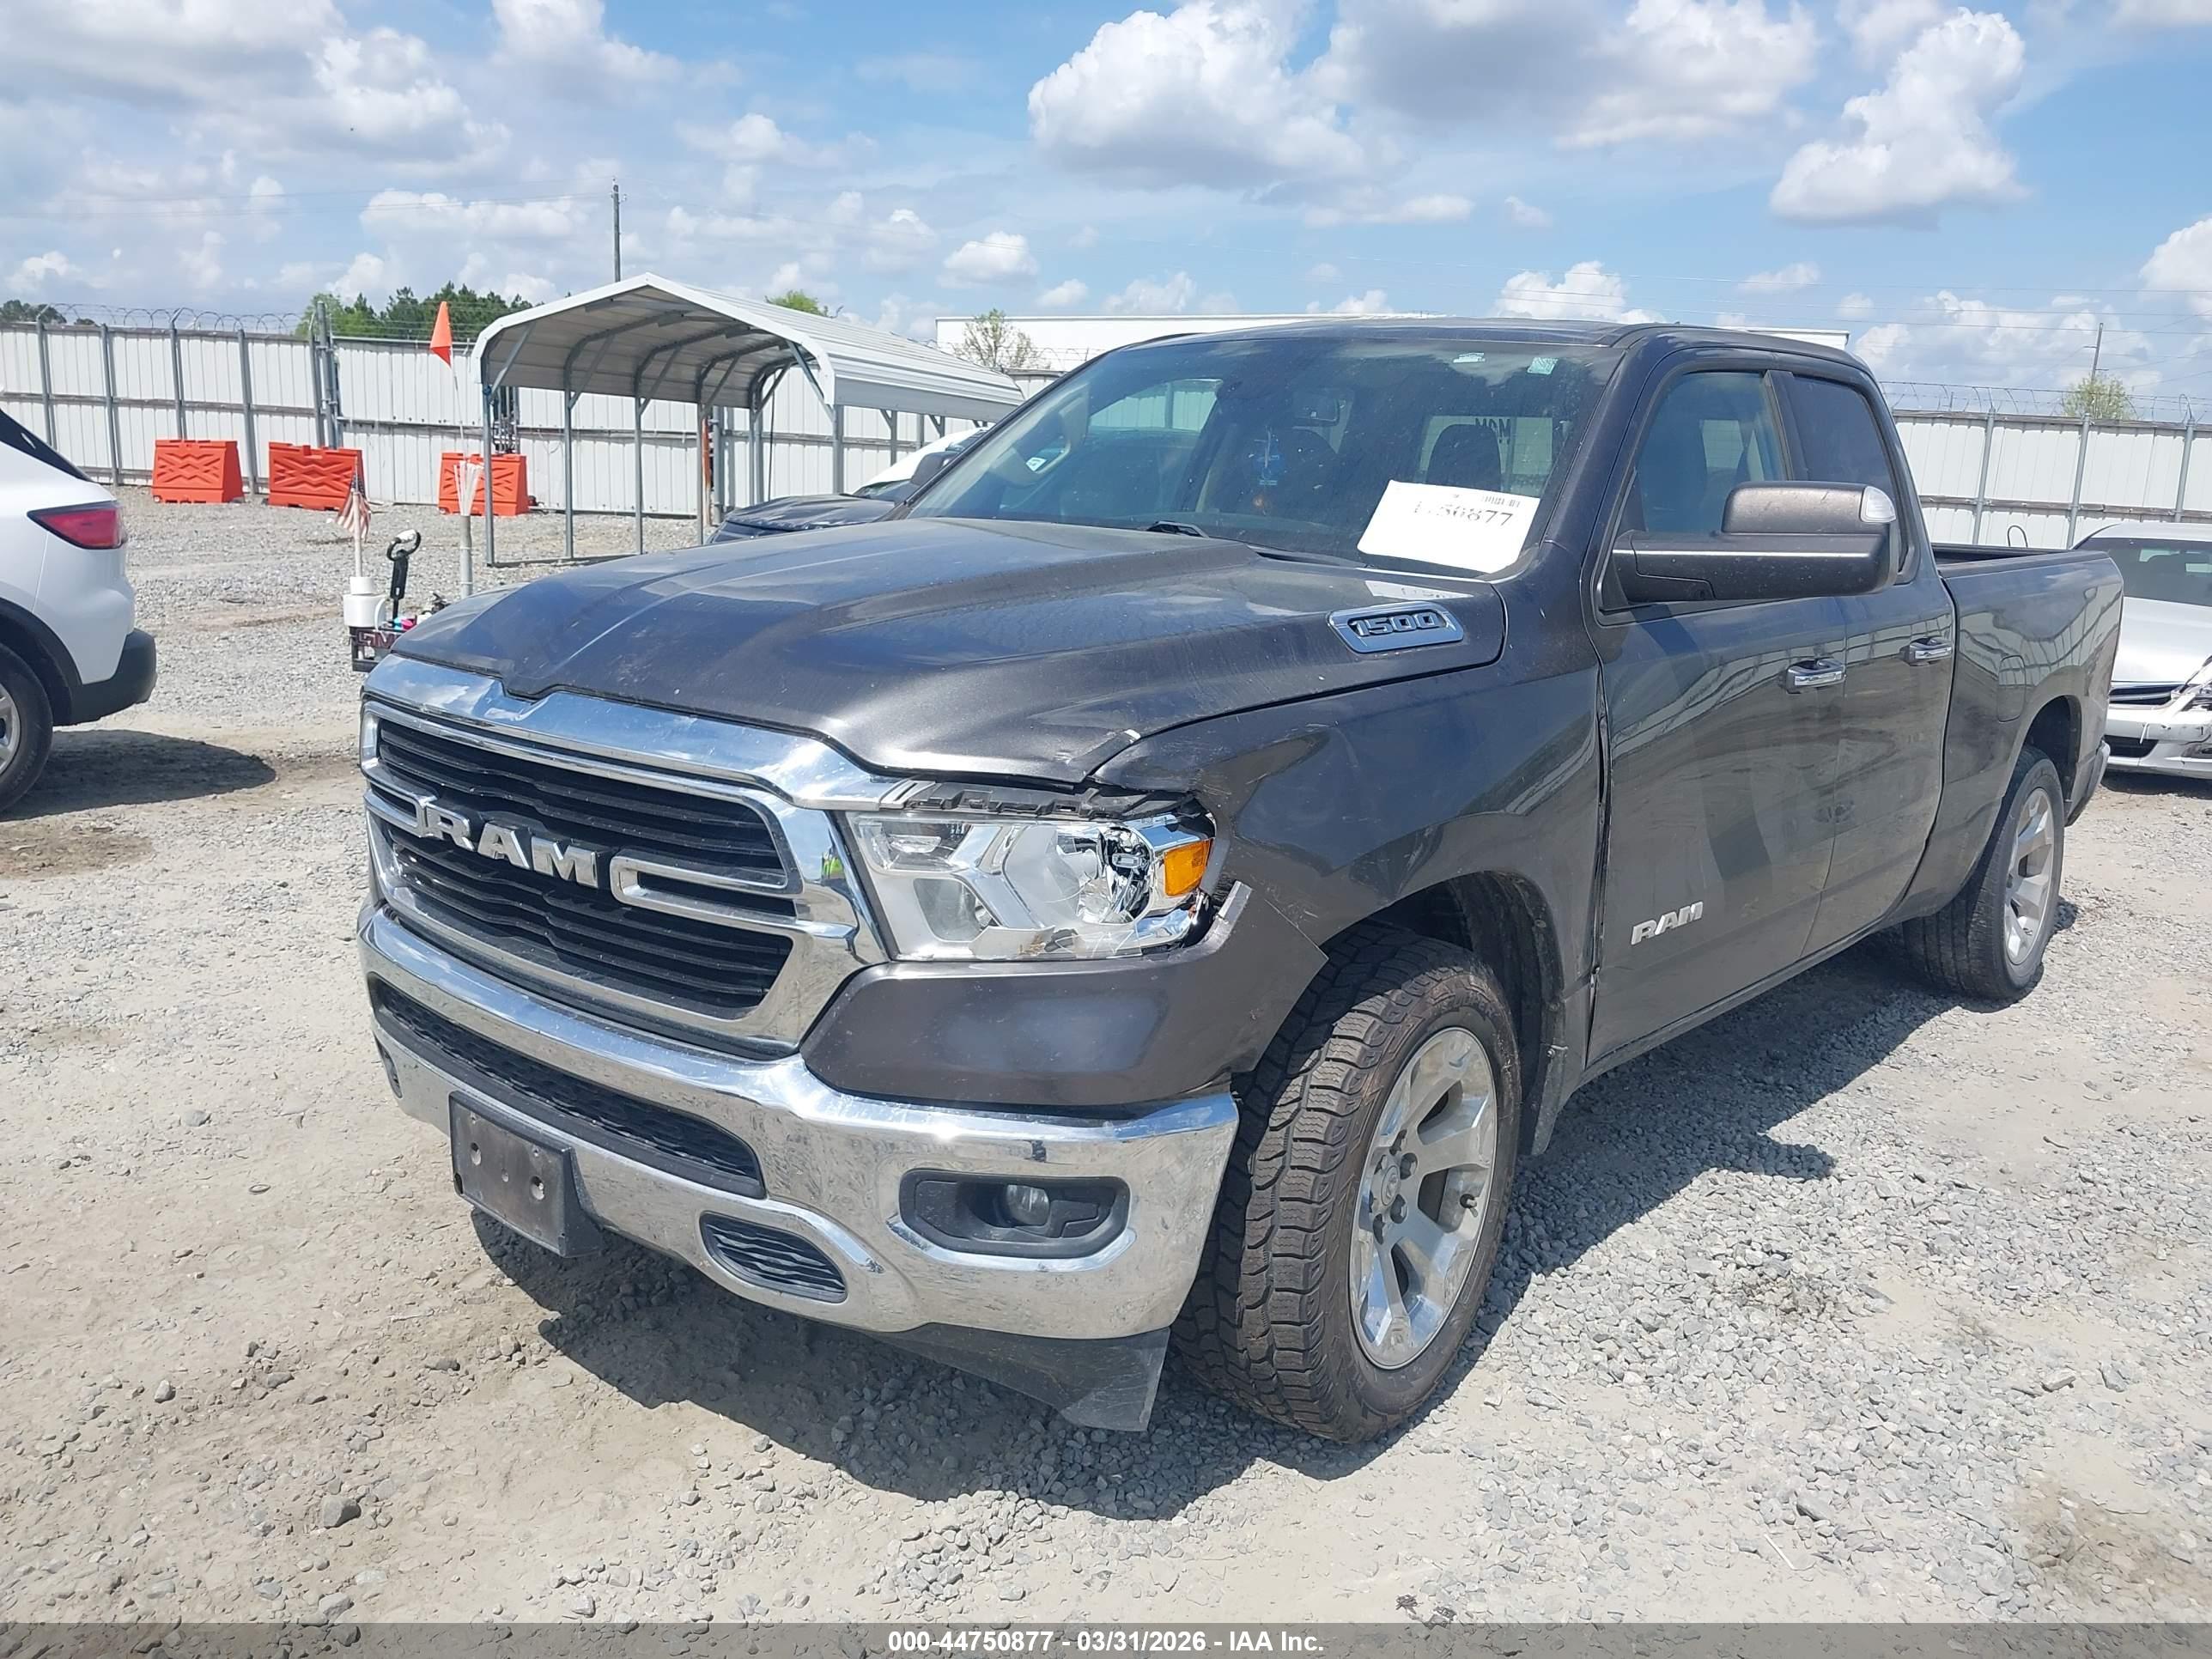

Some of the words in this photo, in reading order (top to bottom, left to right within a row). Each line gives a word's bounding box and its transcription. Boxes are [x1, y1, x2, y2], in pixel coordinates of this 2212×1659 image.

[1349, 611, 1440, 637] 1500
[424, 802, 599, 890] RAM
[1630, 900, 1704, 945] RAM
